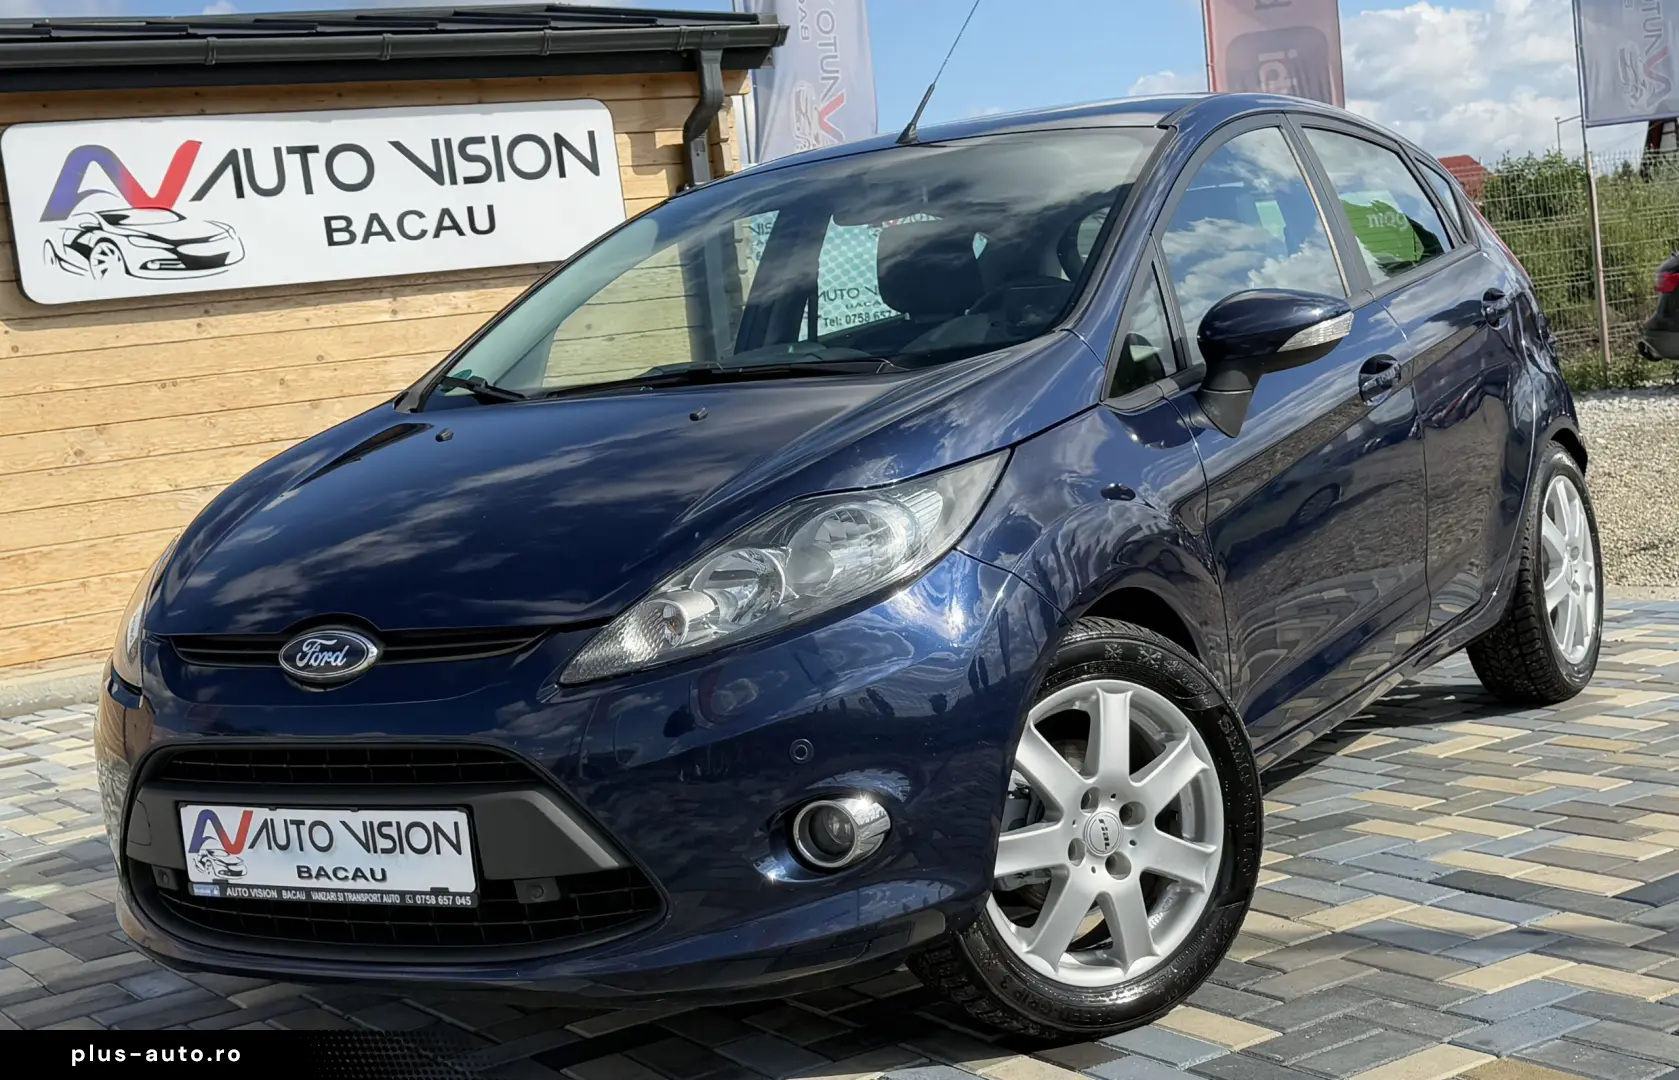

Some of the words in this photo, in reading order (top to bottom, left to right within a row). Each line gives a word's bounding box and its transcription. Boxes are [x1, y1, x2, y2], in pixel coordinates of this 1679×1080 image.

[189, 143, 375, 202] AUTO
[388, 130, 600, 186] VISION
[323, 204, 497, 247] BACAU
[845, 311, 870, 325] 0758
[296, 638, 350, 667] Ford
[248, 817, 334, 853] AUTO
[339, 819, 463, 856] VISION
[296, 865, 387, 883] BACAU
[226, 886, 249, 897] AUTO
[250, 887, 278, 899] VISION
[282, 889, 306, 900] BACAU
[310, 890, 337, 901] VANZARI
[344, 892, 381, 903] TRANSPORT
[382, 893, 401, 904] AUTO
[415, 894, 437, 905] 0758
[438, 895, 453, 905] 657
[455, 895, 472, 906] 045
